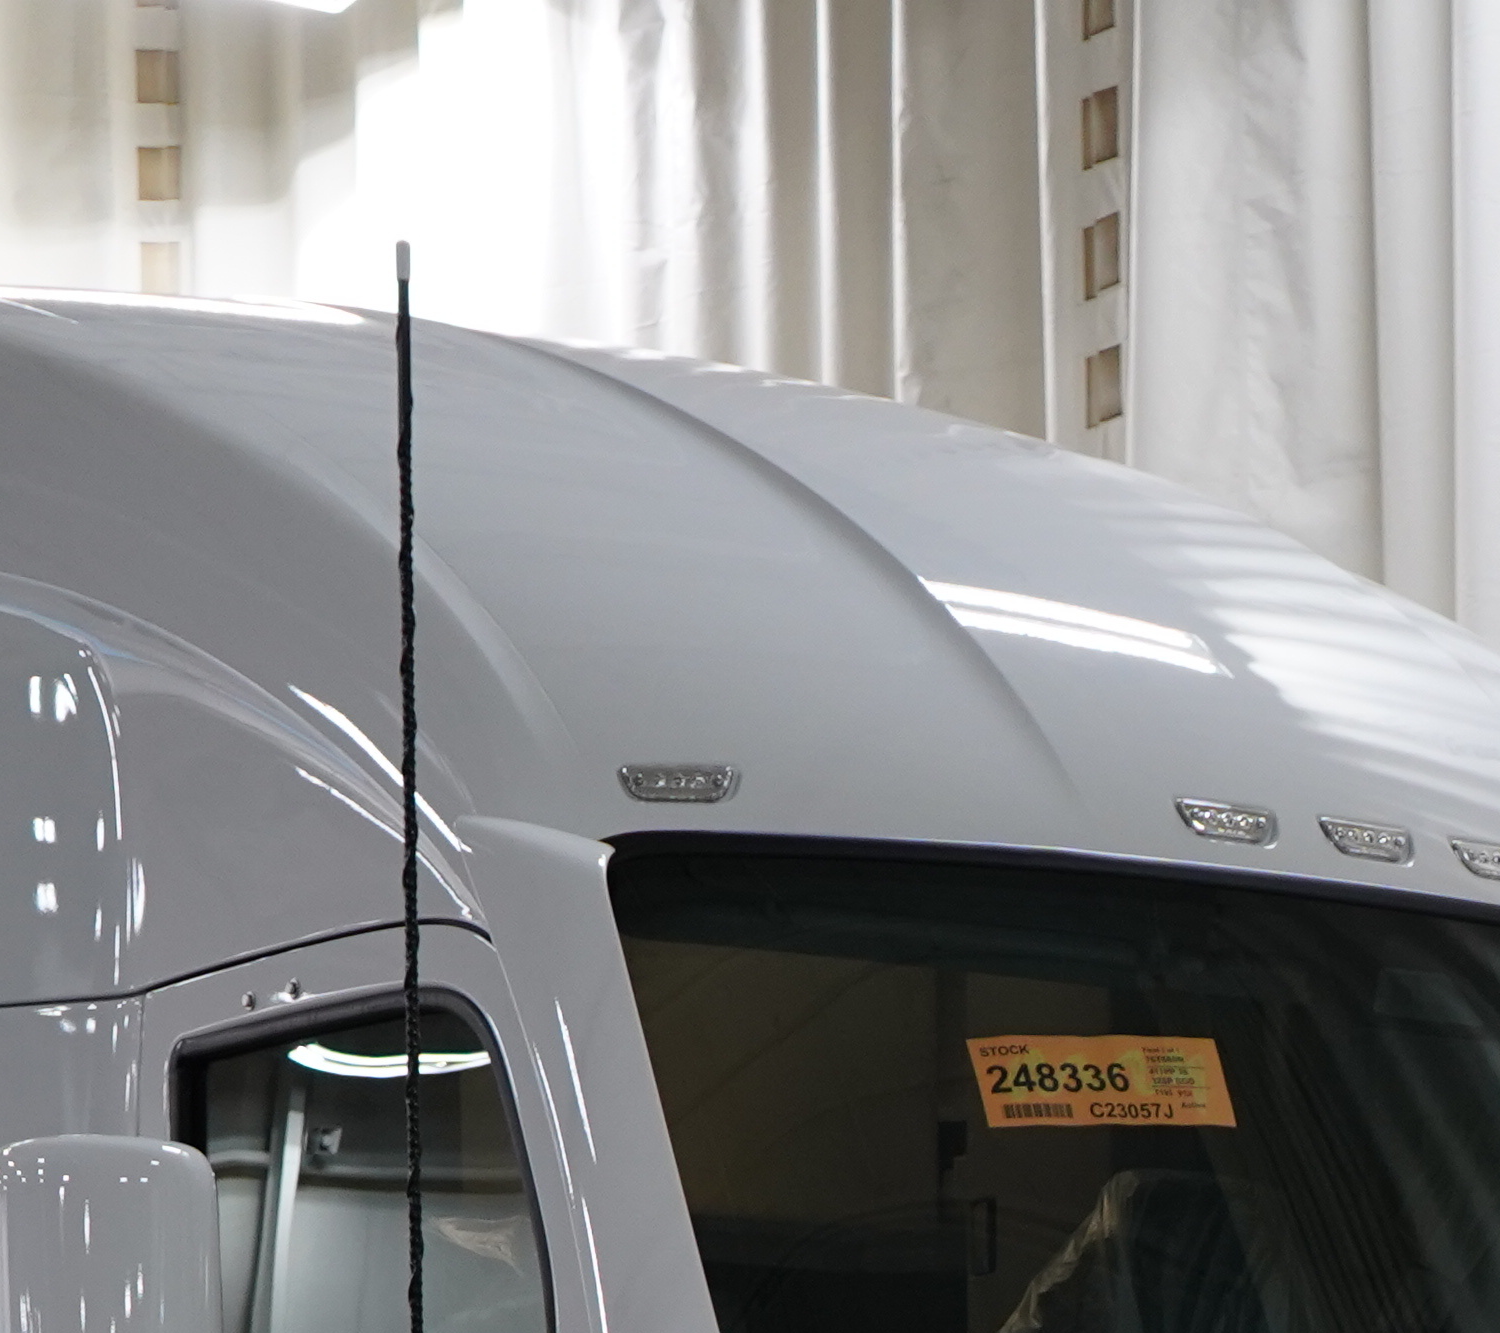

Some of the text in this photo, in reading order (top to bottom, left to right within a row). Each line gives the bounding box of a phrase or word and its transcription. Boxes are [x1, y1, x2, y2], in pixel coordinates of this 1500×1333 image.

[979, 1043, 1030, 1058] STOCK
[986, 1062, 1130, 1094] 248336
[1089, 1101, 1174, 1119] C23057J
